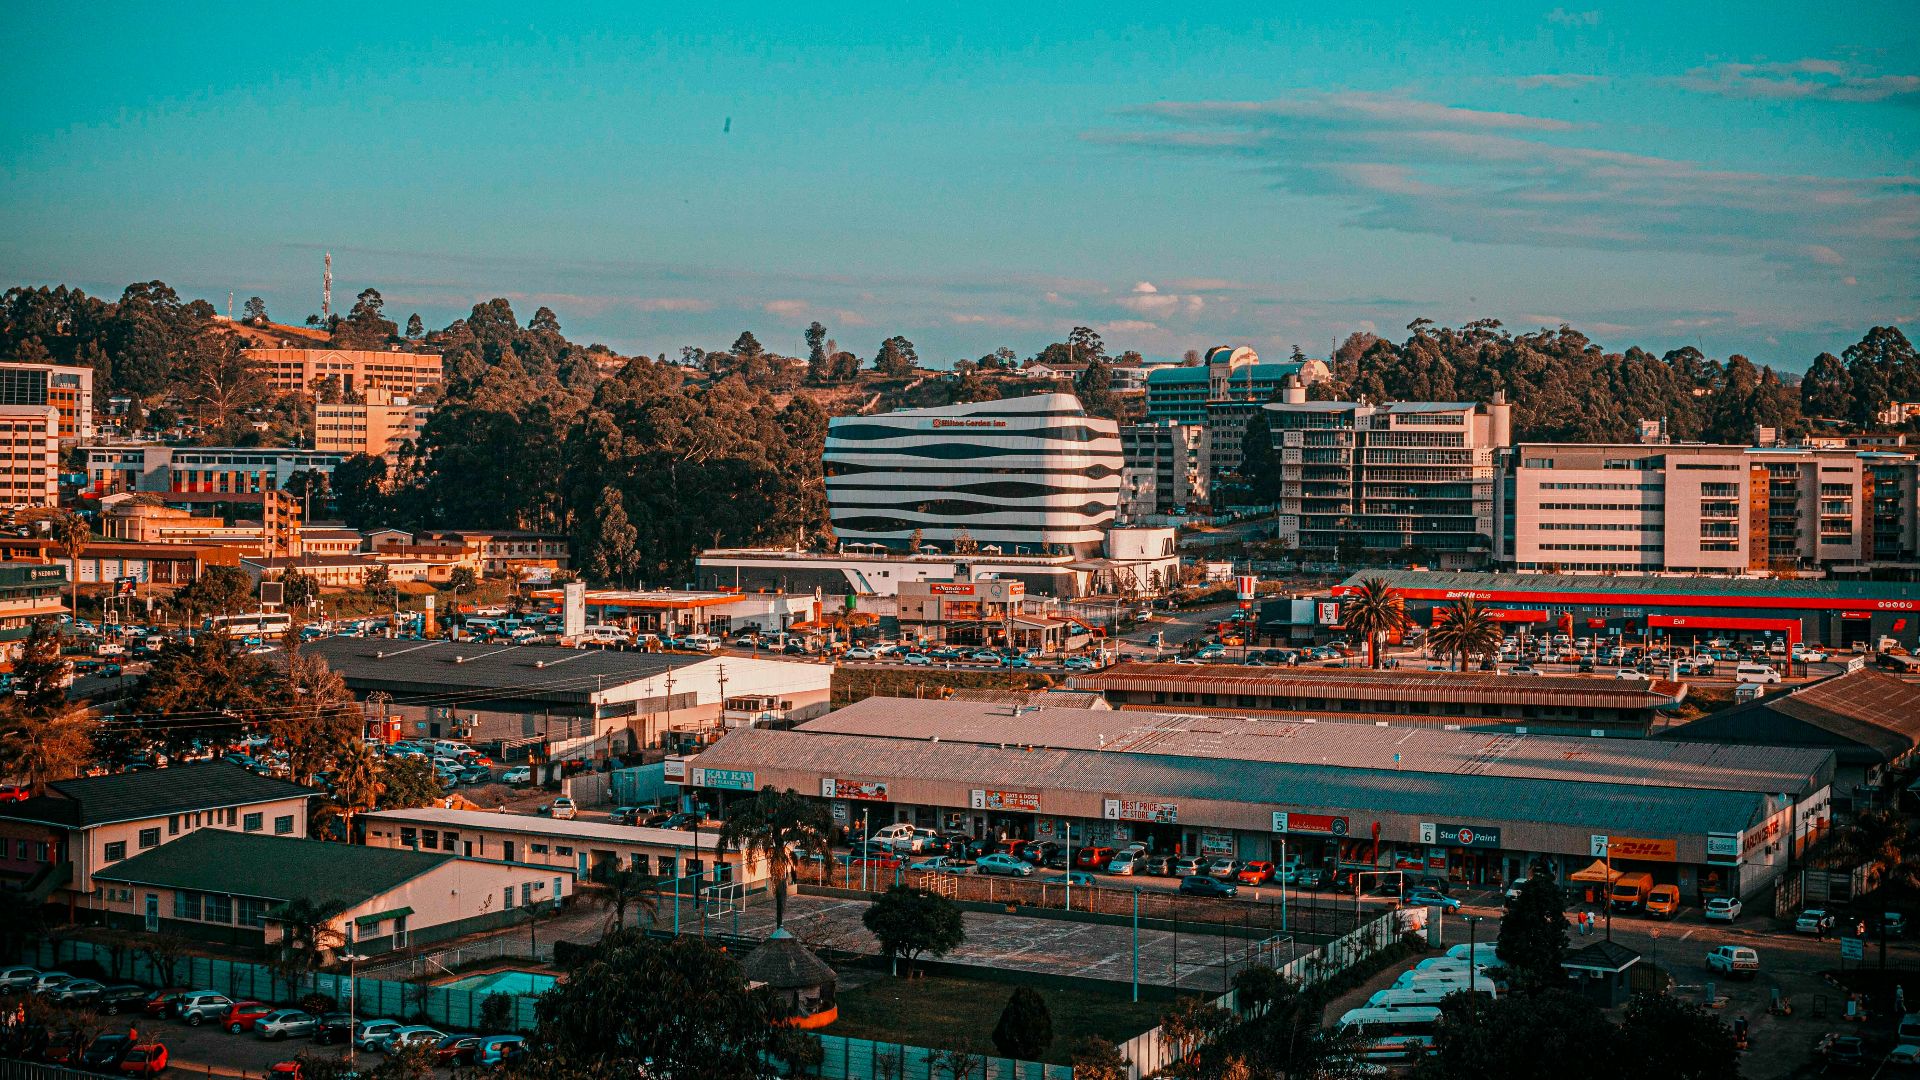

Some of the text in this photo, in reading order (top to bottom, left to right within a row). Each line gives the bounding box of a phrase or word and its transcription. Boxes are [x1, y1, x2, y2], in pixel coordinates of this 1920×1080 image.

[696, 776, 702, 785] 1
[706, 770, 728, 780] KAY
[731, 771, 752, 782] KAY
[826, 786, 832, 796] 2
[976, 798, 982, 807] 3
[1121, 800, 1137, 810] BEST
[1140, 802, 1158, 811] PRICE
[1108, 808, 1115, 817] 4
[1130, 810, 1149, 819] STORE
[1276, 821, 1283, 831] 5
[1424, 832, 1431, 842] 6
[1440, 830, 1497, 842] Star Paint
[1595, 842, 1604, 855] 7
[1620, 842, 1662, 855] DHL
